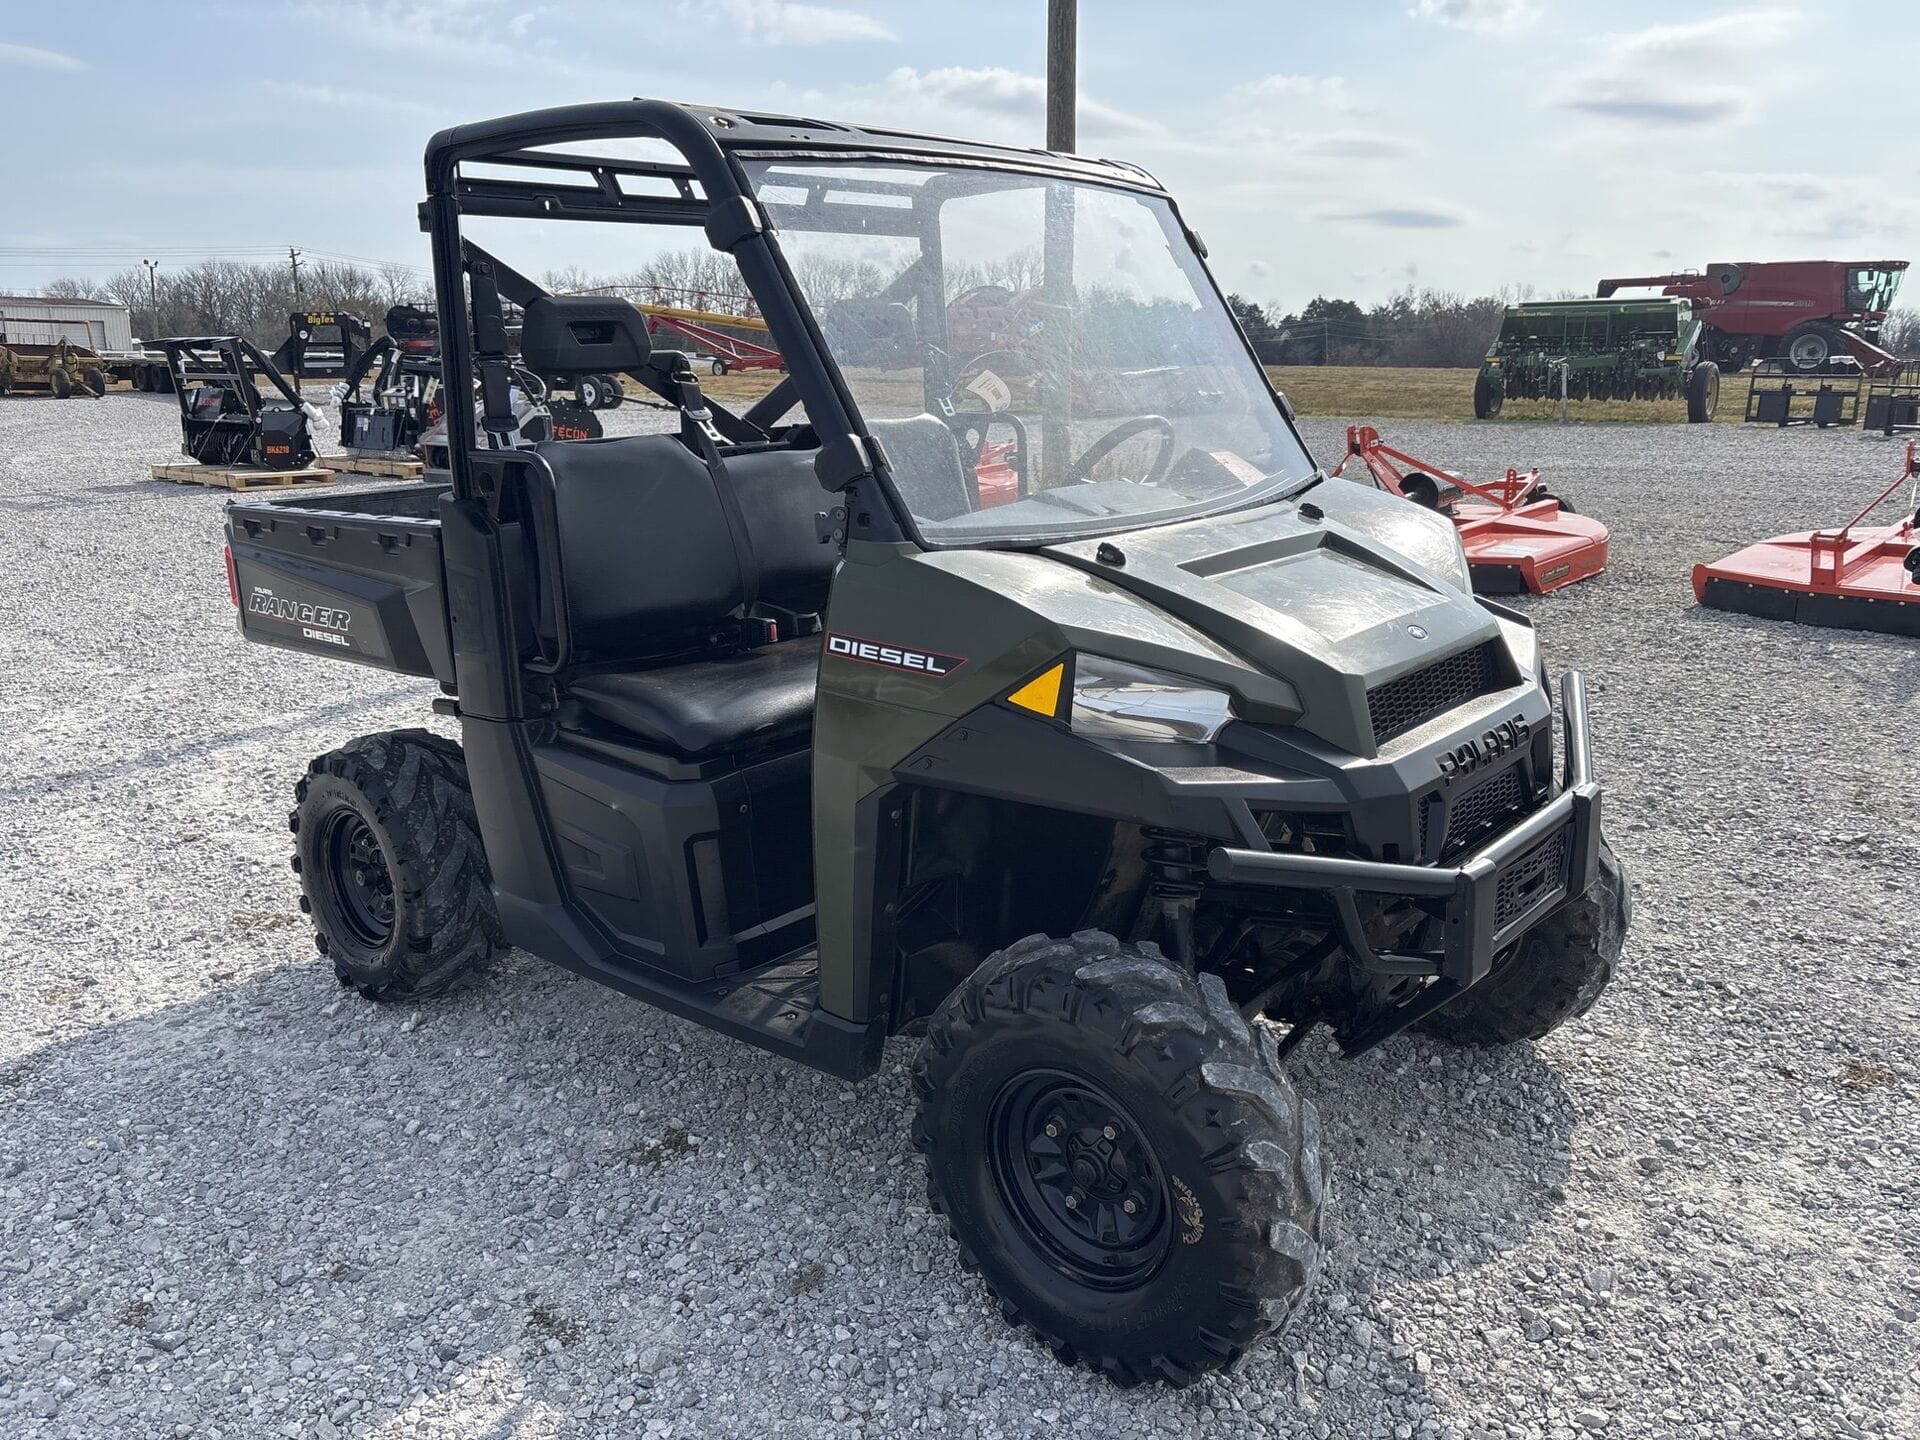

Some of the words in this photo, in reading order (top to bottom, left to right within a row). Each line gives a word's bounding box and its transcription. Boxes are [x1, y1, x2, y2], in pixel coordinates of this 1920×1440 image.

[553, 425, 587, 440] FECON
[249, 593, 351, 631] RANGER
[303, 628, 350, 646] DIESEL
[829, 637, 946, 674] DIESEL
[1437, 713, 1530, 787] POLARIS
